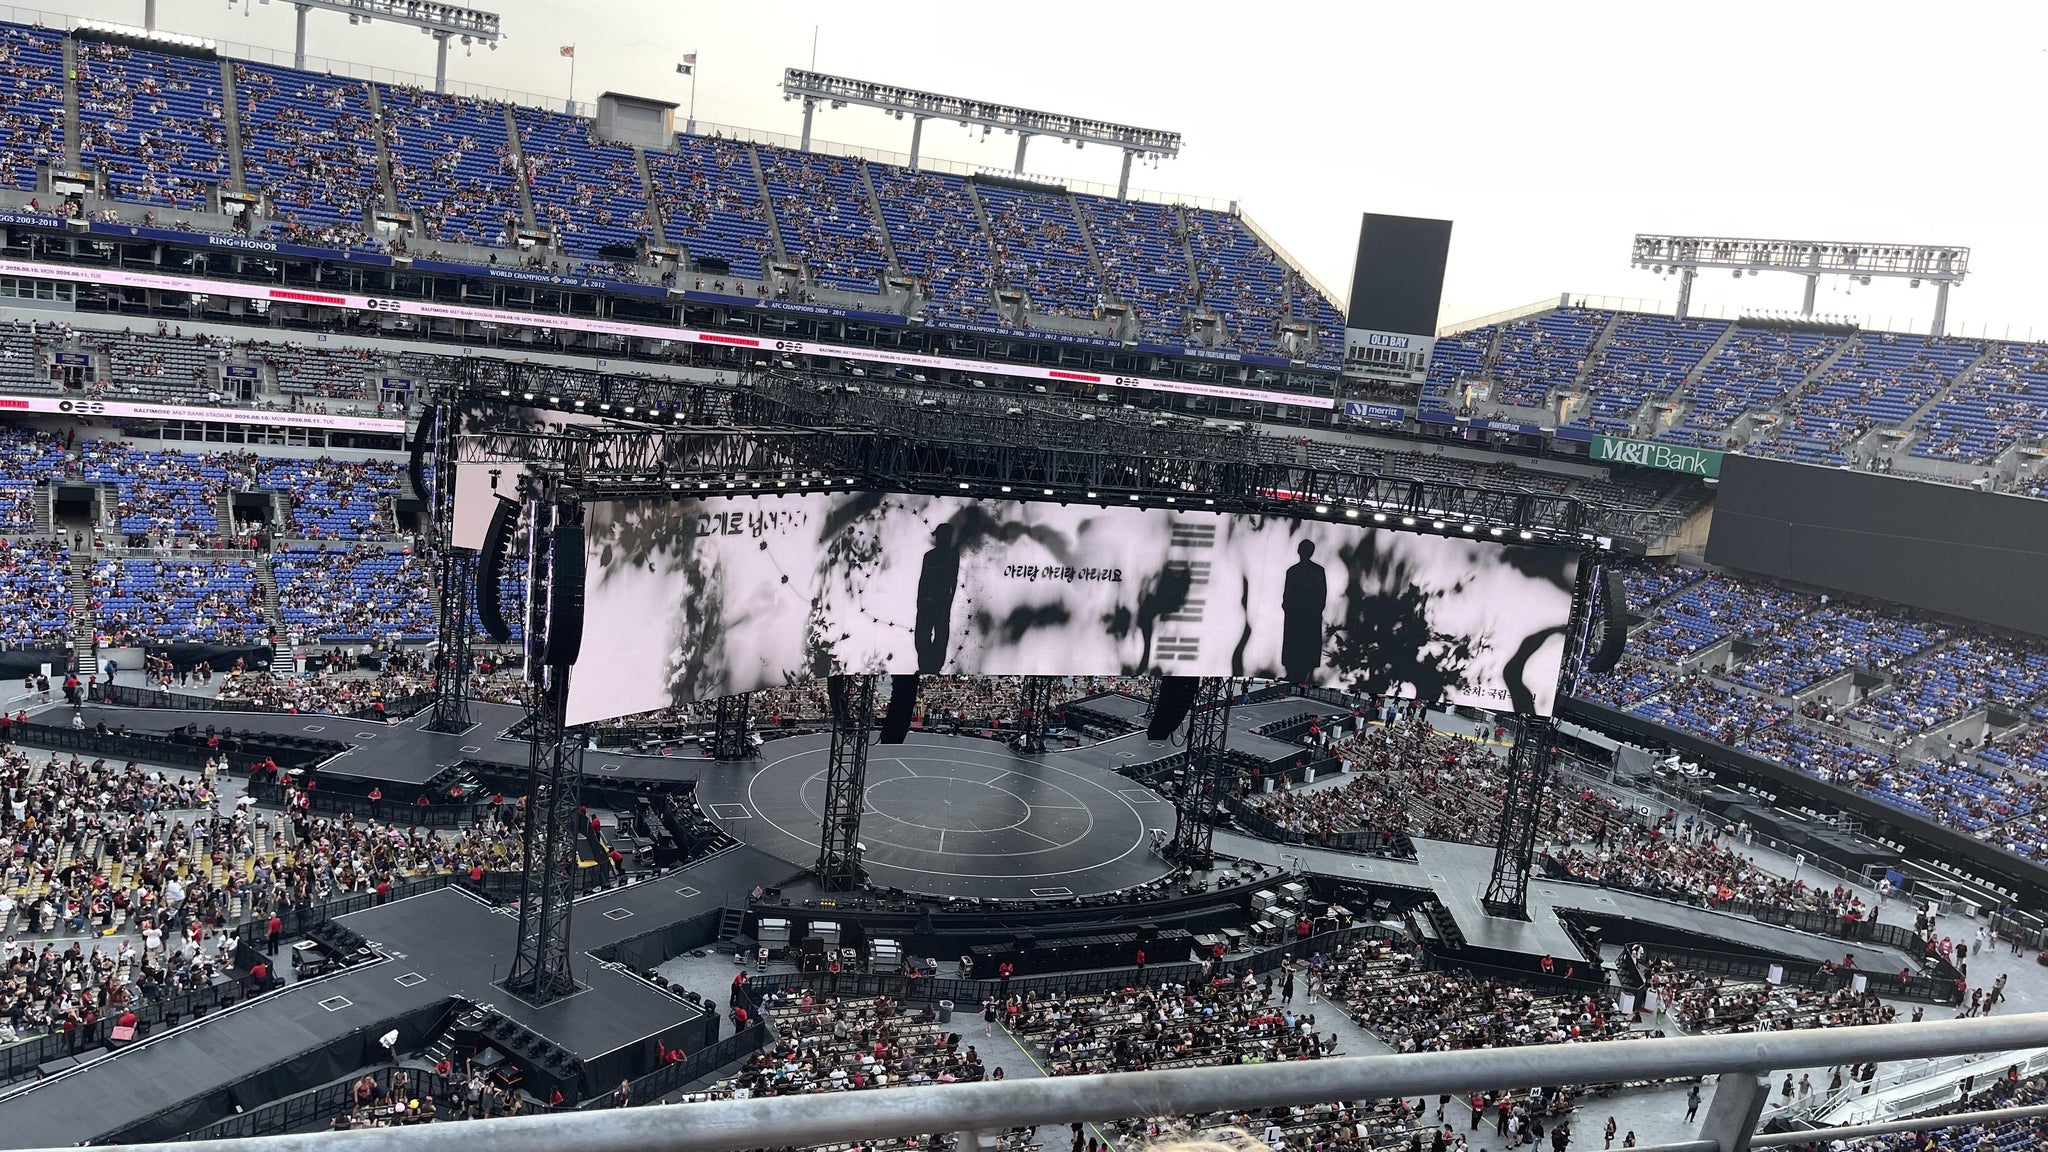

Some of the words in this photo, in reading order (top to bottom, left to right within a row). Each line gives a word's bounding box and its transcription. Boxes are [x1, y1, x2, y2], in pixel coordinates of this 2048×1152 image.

[16, 216, 58, 227] 2003-2018
[209, 236, 234, 246] RING
[240, 241, 277, 251] HONOR
[490, 269, 513, 278] WORLD
[514, 272, 550, 282] CHAMPIONS
[562, 278, 578, 286] 2000
[590, 281, 606, 289] 2012
[782, 303, 814, 313] CHAMPIONS
[966, 325, 996, 333] CHAMPIONS
[1371, 335, 1389, 346] OLD
[1389, 337, 1407, 348] BAY
[1369, 407, 1397, 416] merritt
[1600, 438, 1655, 465] M&T
[1655, 448, 1708, 474] Bank
[695, 511, 744, 537] 고개로
[1003, 564, 1039, 582] 아리랑
[1041, 566, 1076, 583] 아리랑
[1078, 567, 1122, 582] 아라리요
[1462, 684, 1485, 697] 출처:
[1759, 1021, 1770, 1031] N
[1267, 1129, 1277, 1142] L
